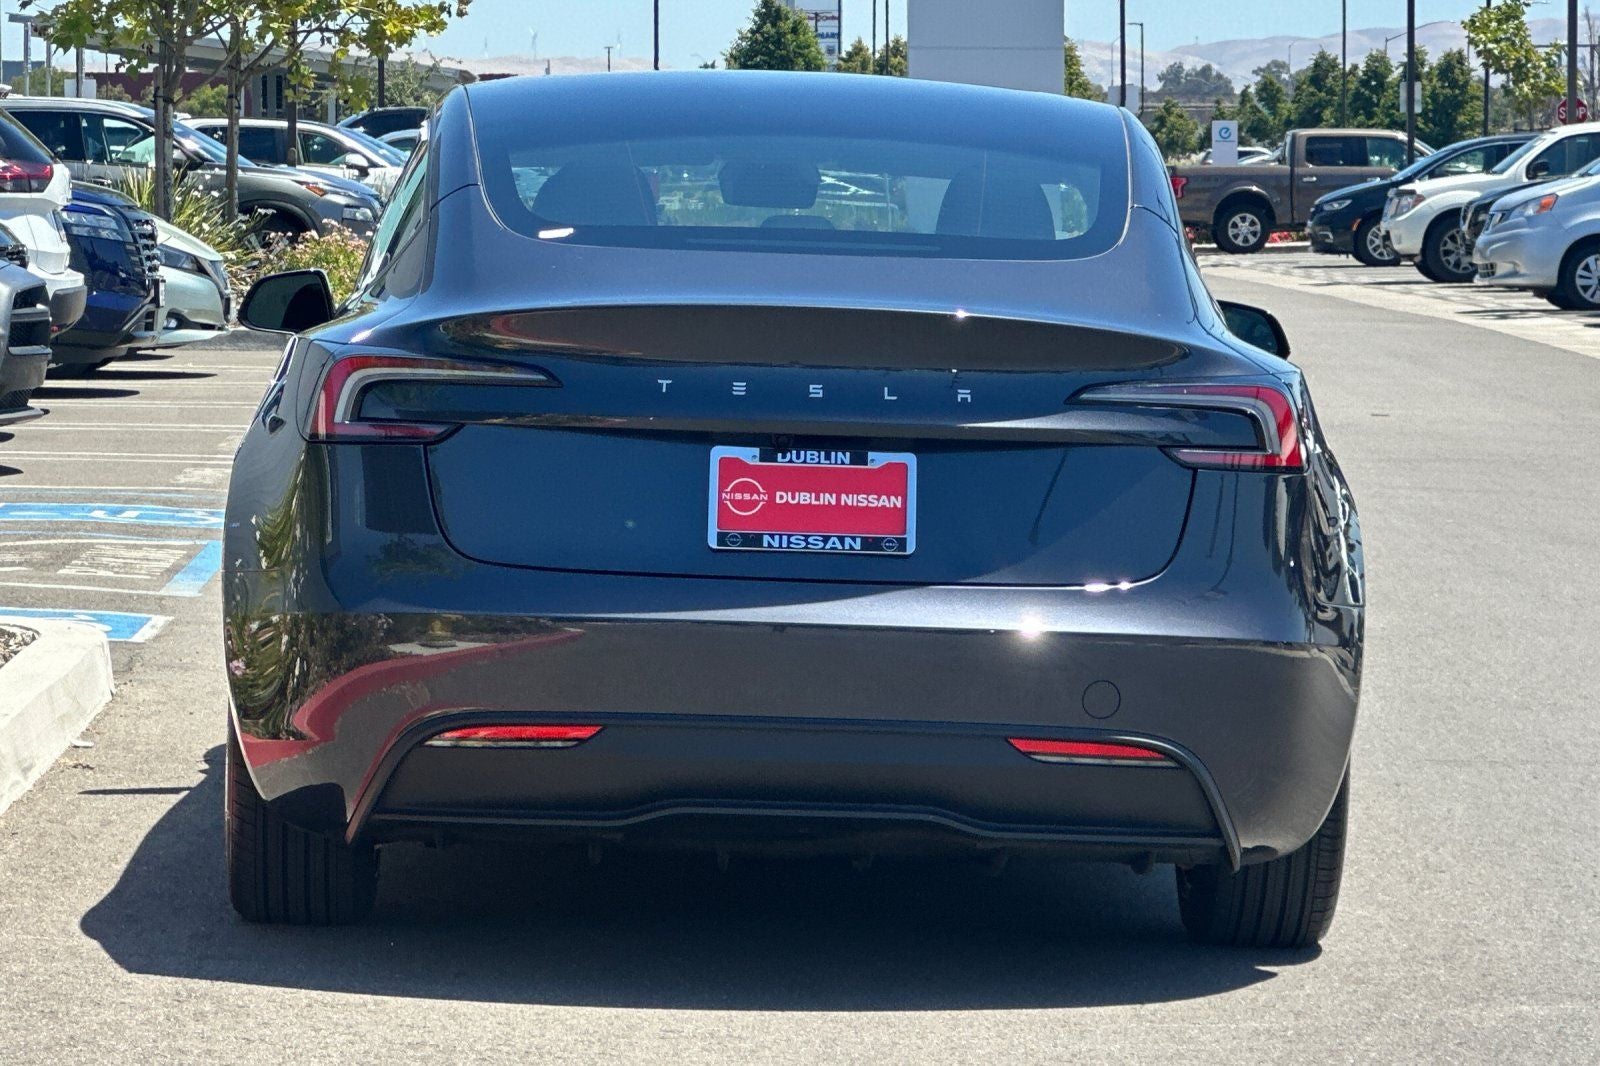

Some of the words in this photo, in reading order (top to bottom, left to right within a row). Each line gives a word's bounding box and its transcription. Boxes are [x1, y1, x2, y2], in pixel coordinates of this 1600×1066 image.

[1559, 107, 1586, 119] SP
[777, 450, 850, 464] DUBLIN
[722, 493, 768, 501] NISSAN
[775, 491, 836, 506] DUBLIN
[841, 493, 902, 508] NISSAN
[762, 534, 861, 550] NISSAN
